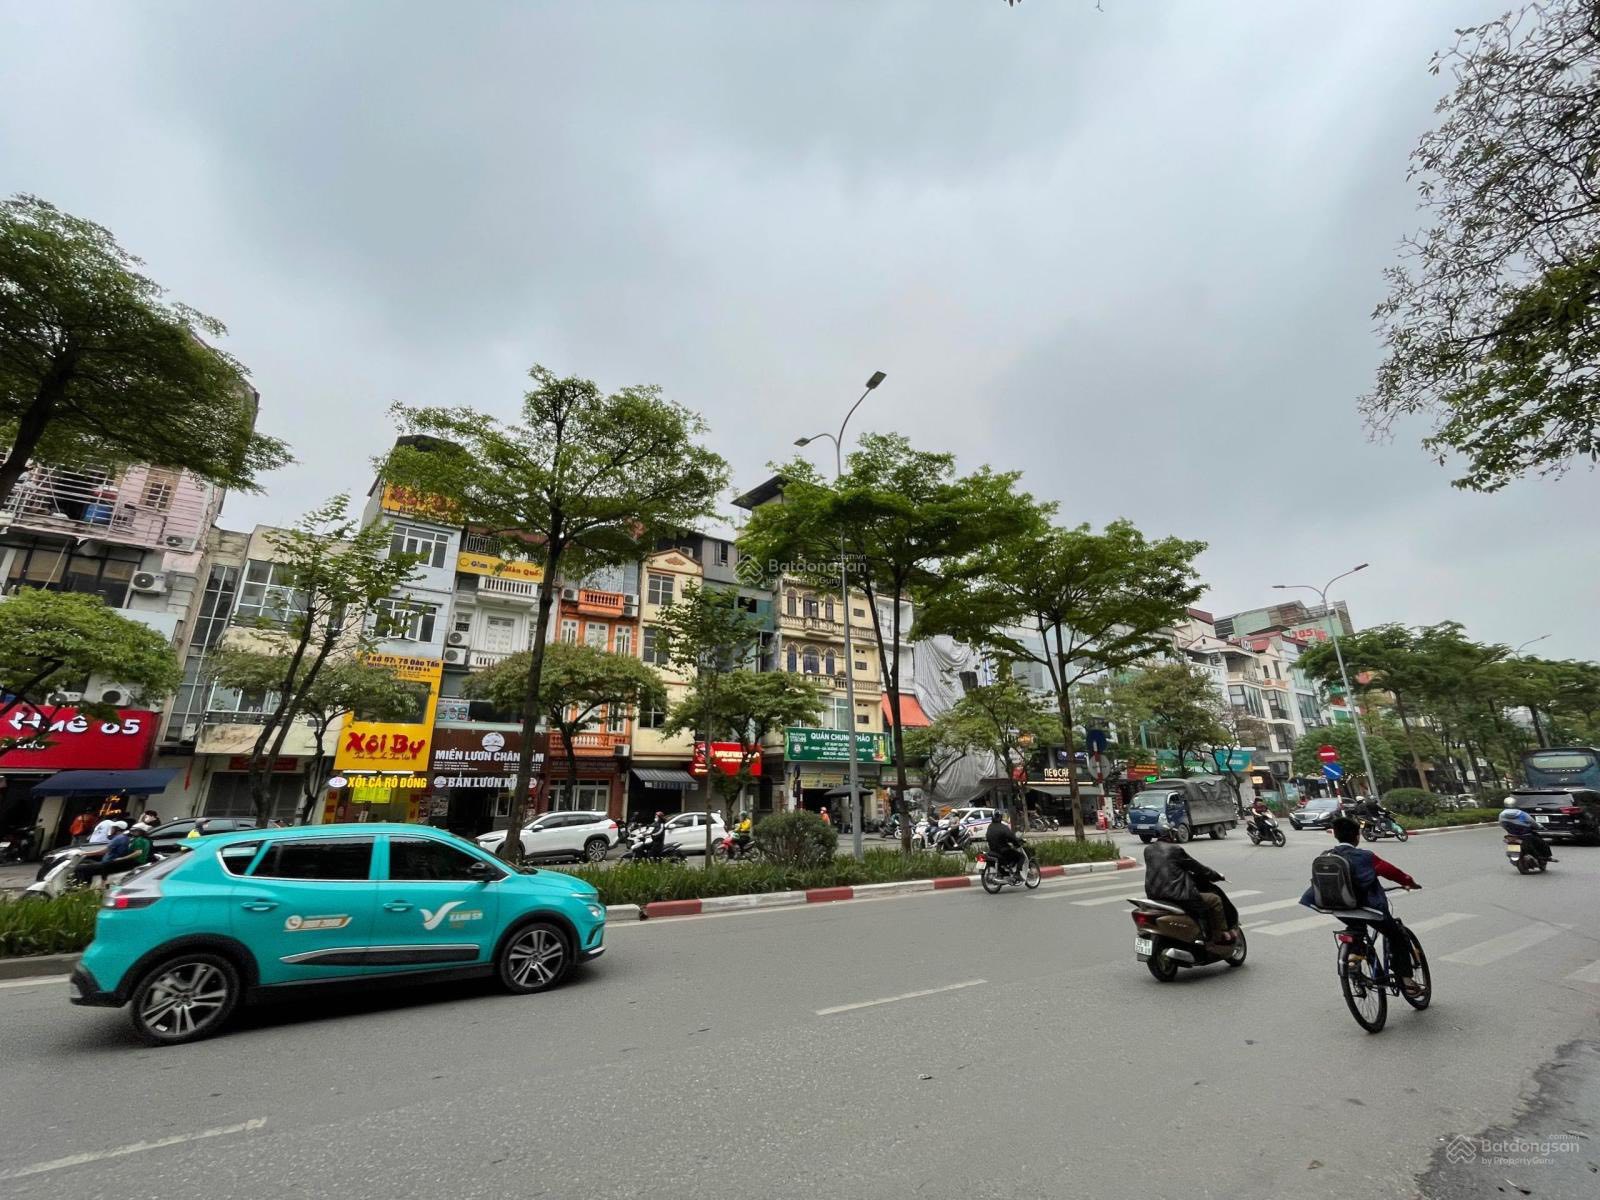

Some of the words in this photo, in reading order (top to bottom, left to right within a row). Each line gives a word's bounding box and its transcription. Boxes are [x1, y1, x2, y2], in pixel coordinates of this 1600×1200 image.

[346, 732, 387, 753] Xôi
[830, 733, 850, 742] CHUN
[434, 747, 463, 761] MIẾN
[464, 750, 491, 761] LƯƠN
[493, 750, 521, 762] CHÂN
[473, 776, 503, 788] LƯƠN
